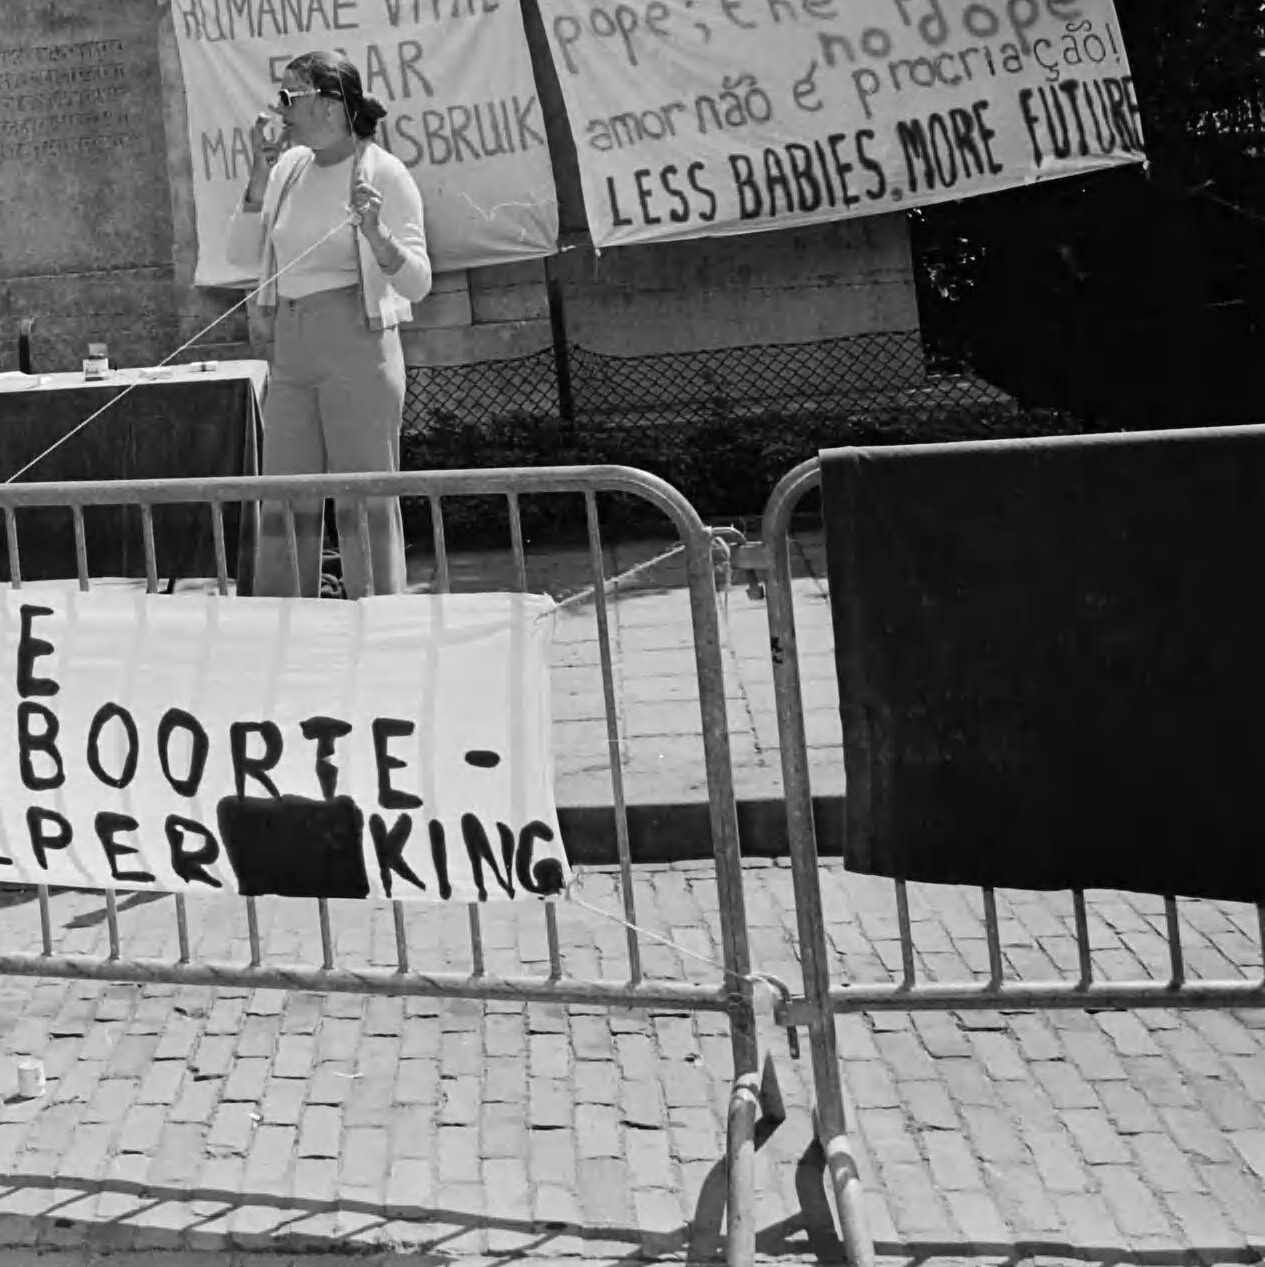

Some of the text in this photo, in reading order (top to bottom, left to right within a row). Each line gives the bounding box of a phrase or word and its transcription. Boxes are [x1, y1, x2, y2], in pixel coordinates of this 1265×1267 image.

[818, 27, 891, 67] no
[586, 101, 685, 152] amor
[694, 73, 772, 135] não
[793, 59, 823, 112] é
[606, 160, 718, 226] LESS
[896, 99, 1003, 193] MORE
